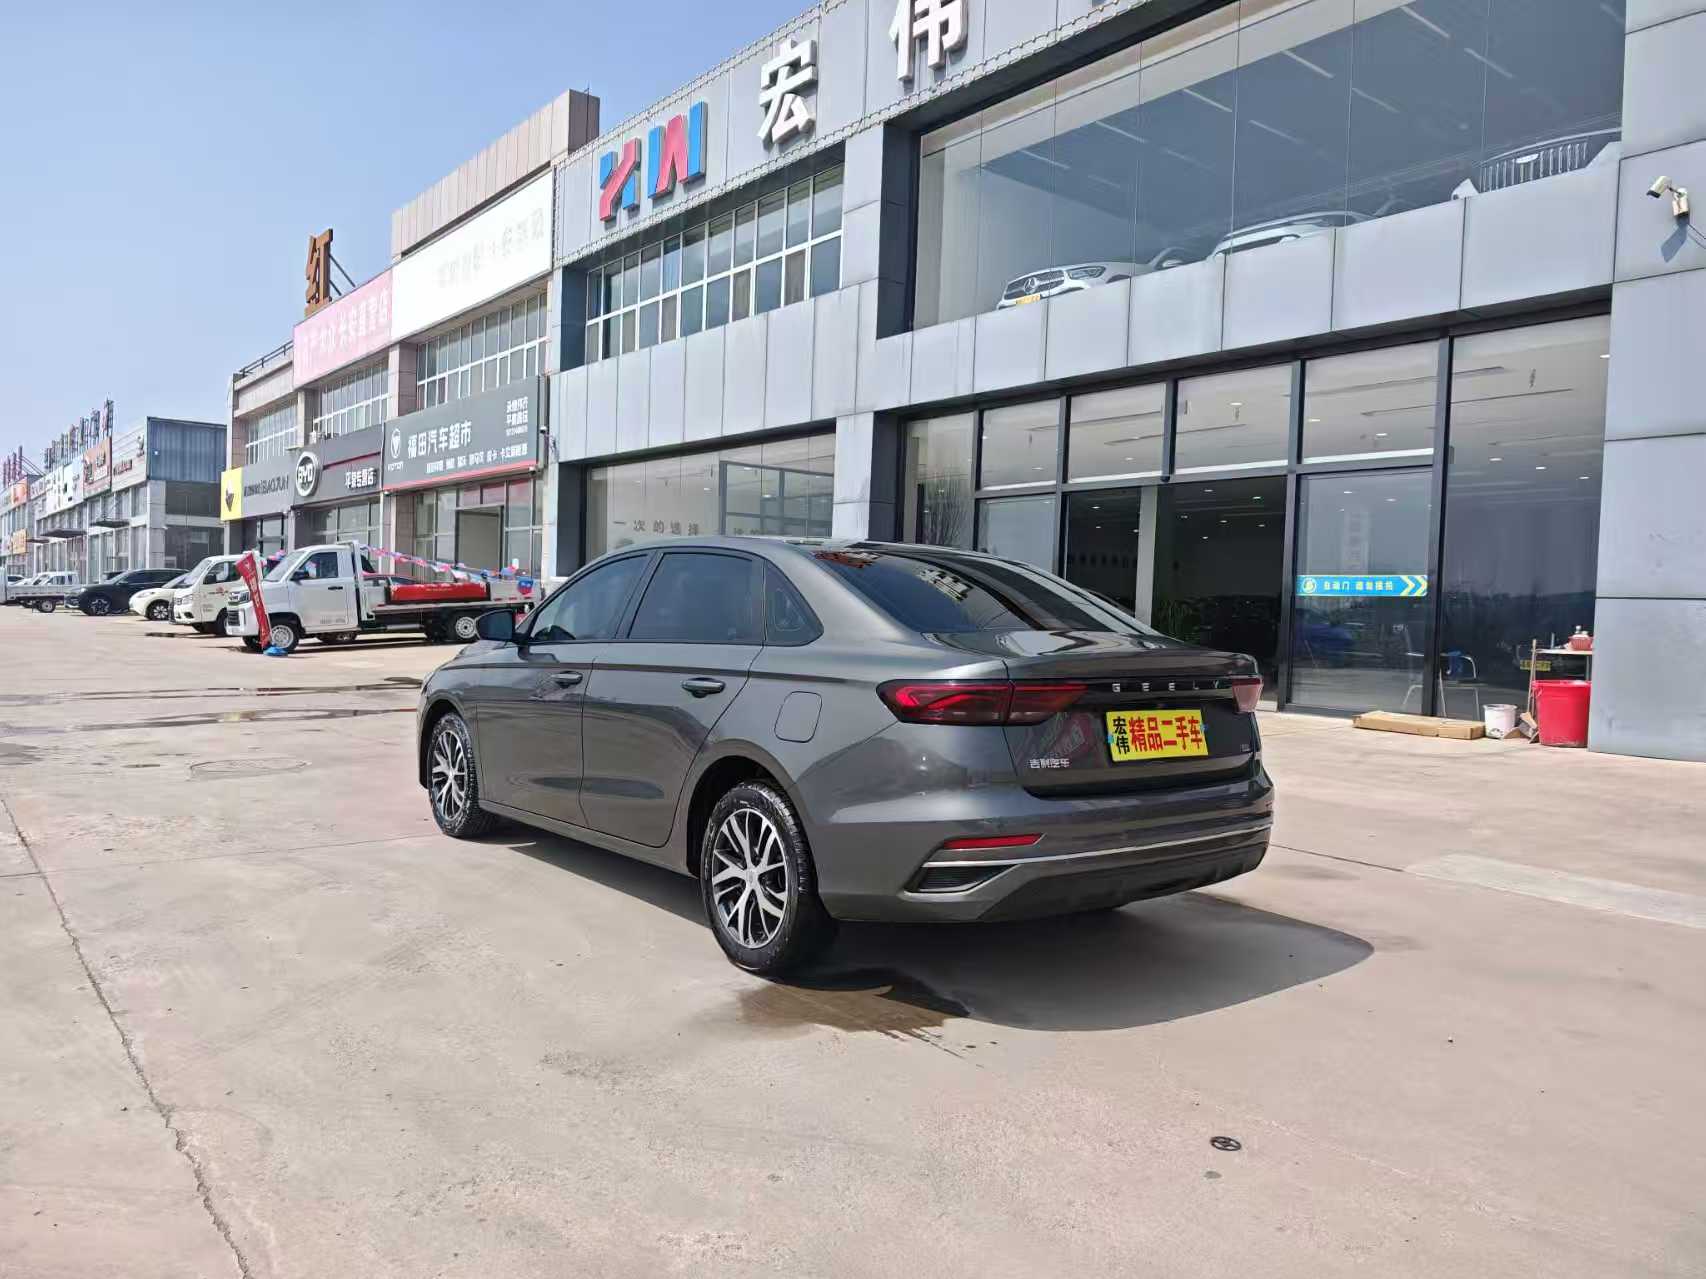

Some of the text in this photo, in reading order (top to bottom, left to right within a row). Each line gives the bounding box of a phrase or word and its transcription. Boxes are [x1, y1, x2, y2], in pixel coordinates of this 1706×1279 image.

[407, 420, 473, 459] 福田汽车超市
[298, 464, 314, 483] BYD
[1112, 682, 1220, 693] GEELY
[1112, 715, 1131, 755] 宏伟
[1129, 715, 1203, 753] 精品二手车
